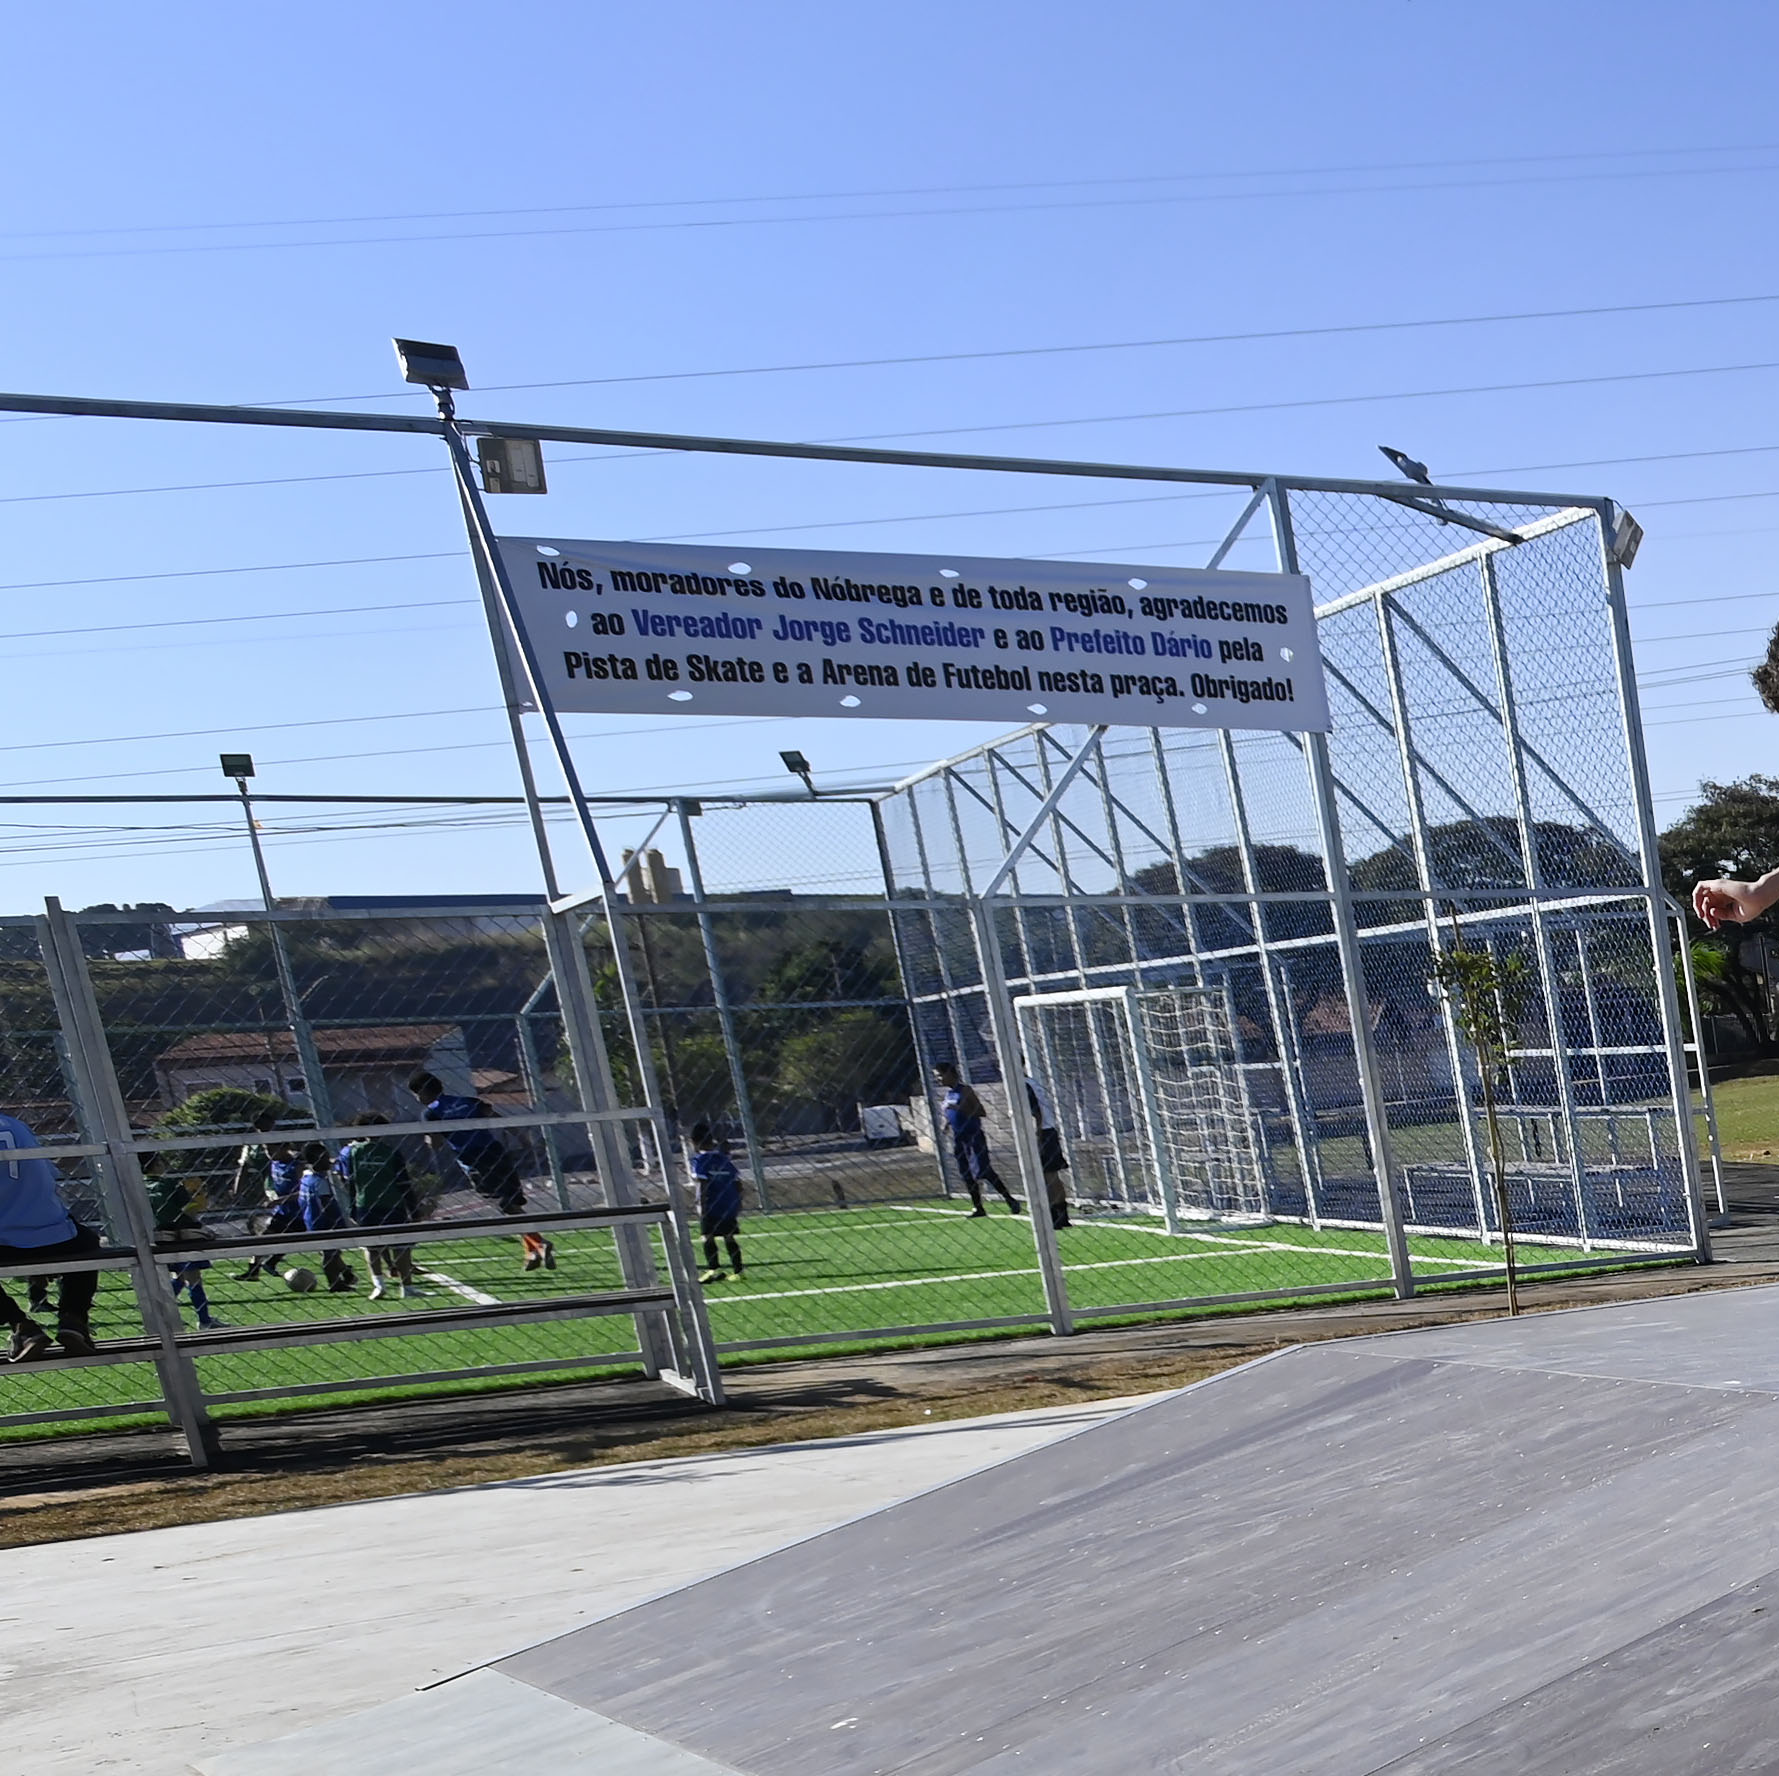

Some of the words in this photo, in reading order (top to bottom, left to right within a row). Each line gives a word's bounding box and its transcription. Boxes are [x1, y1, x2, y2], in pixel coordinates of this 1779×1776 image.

[536, 561, 604, 596] Nós,
[610, 570, 767, 598] moradores
[772, 576, 807, 600] do
[810, 576, 924, 608] Nóbrega
[928, 585, 946, 608] e
[950, 583, 983, 609] de
[987, 585, 1044, 612] toda
[1048, 588, 1134, 619] região,
[1138, 595, 1289, 625] agradecemos
[591, 612, 626, 636] ao
[631, 608, 764, 640] Vereador
[772, 614, 852, 647] Jorge
[857, 616, 986, 649] Schneider
[992, 626, 1009, 650] e
[1014, 628, 1046, 651] ao
[1050, 626, 1146, 656] Prefeito
[1150, 630, 1213, 660] Dário
[1218, 636, 1265, 664] pela
[563, 651, 639, 681] Pista
[645, 653, 681, 682] de
[686, 653, 766, 684] Skate
[772, 661, 790, 684] e
[796, 661, 814, 685] a
[822, 658, 900, 687] Arena
[906, 661, 938, 688] de
[942, 662, 1032, 692] Futebol
[1037, 668, 1104, 694] nesta
[1109, 672, 1186, 704] praça.
[1190, 672, 1295, 704] Obrigado!
